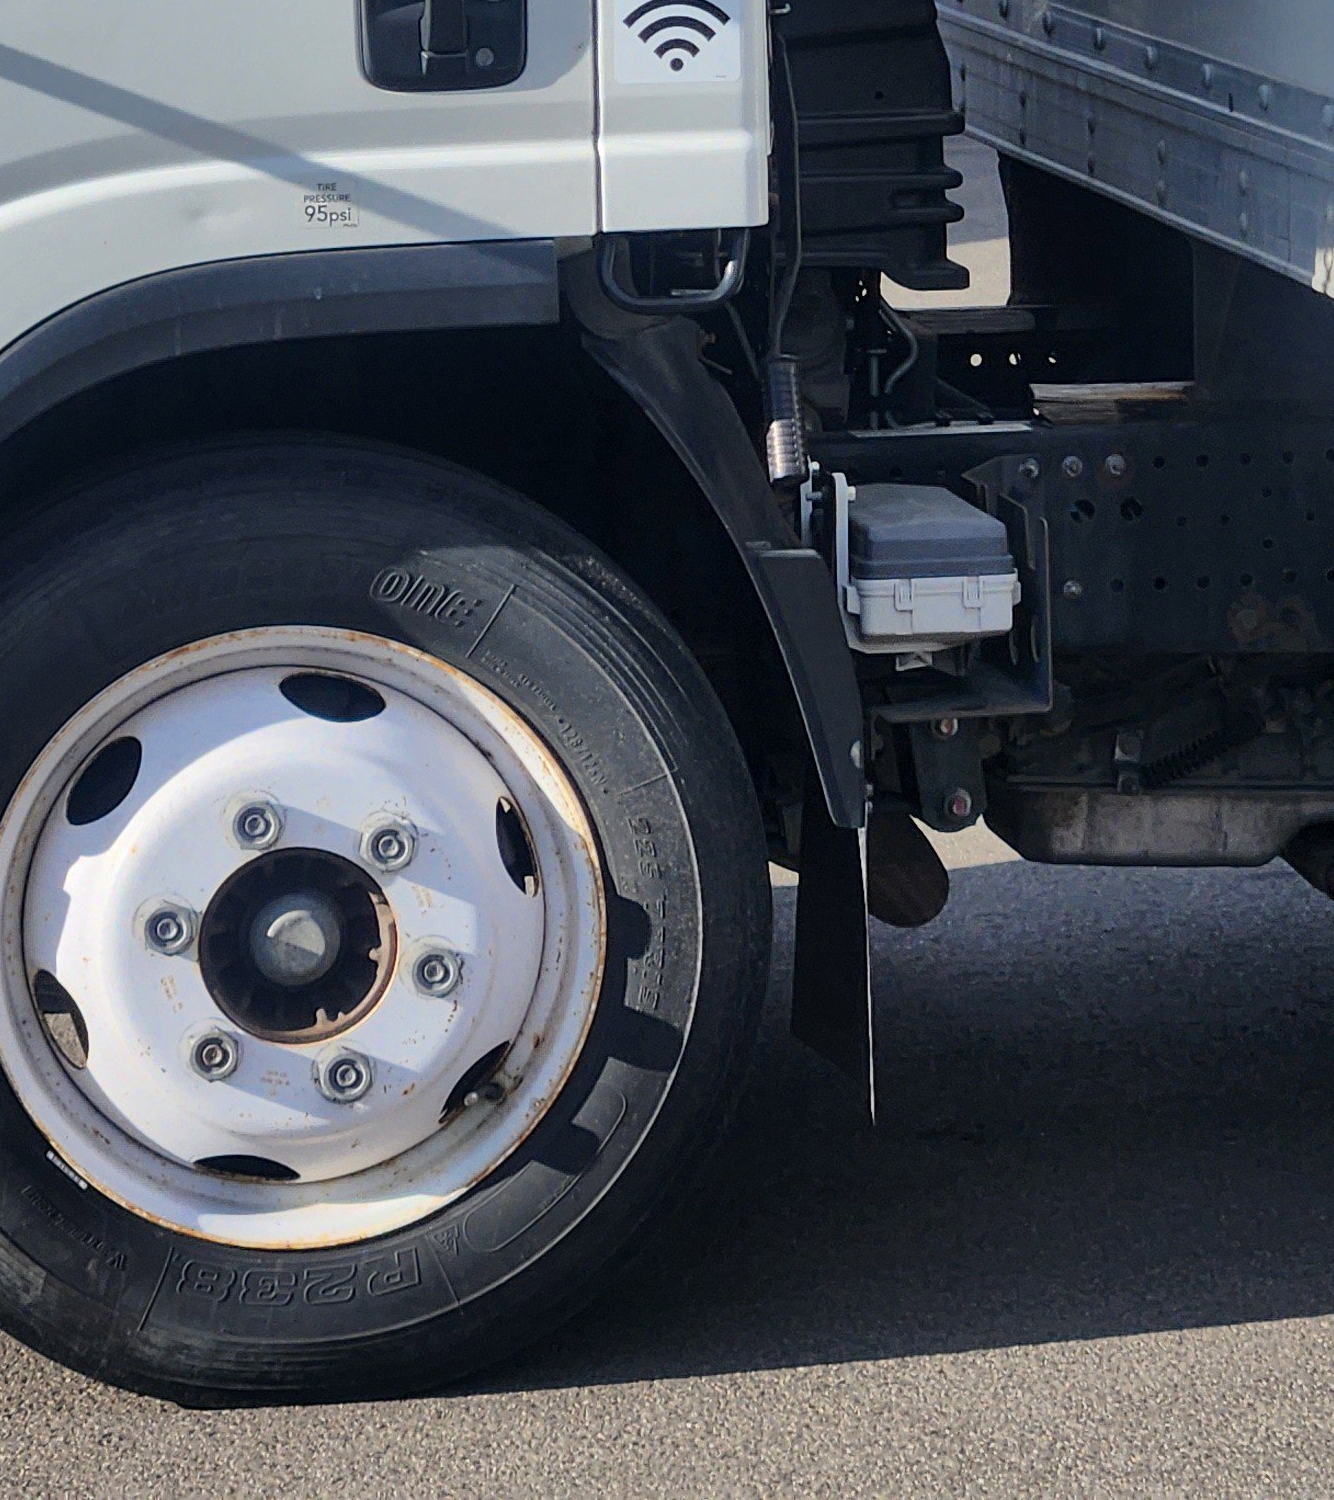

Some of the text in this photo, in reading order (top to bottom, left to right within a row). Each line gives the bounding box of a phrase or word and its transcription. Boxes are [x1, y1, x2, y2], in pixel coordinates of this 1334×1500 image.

[317, 183, 337, 192] TIRE
[303, 193, 352, 204] PRESSURE
[304, 204, 351, 227] 95psi
[176, 1246, 422, 1306] R238
